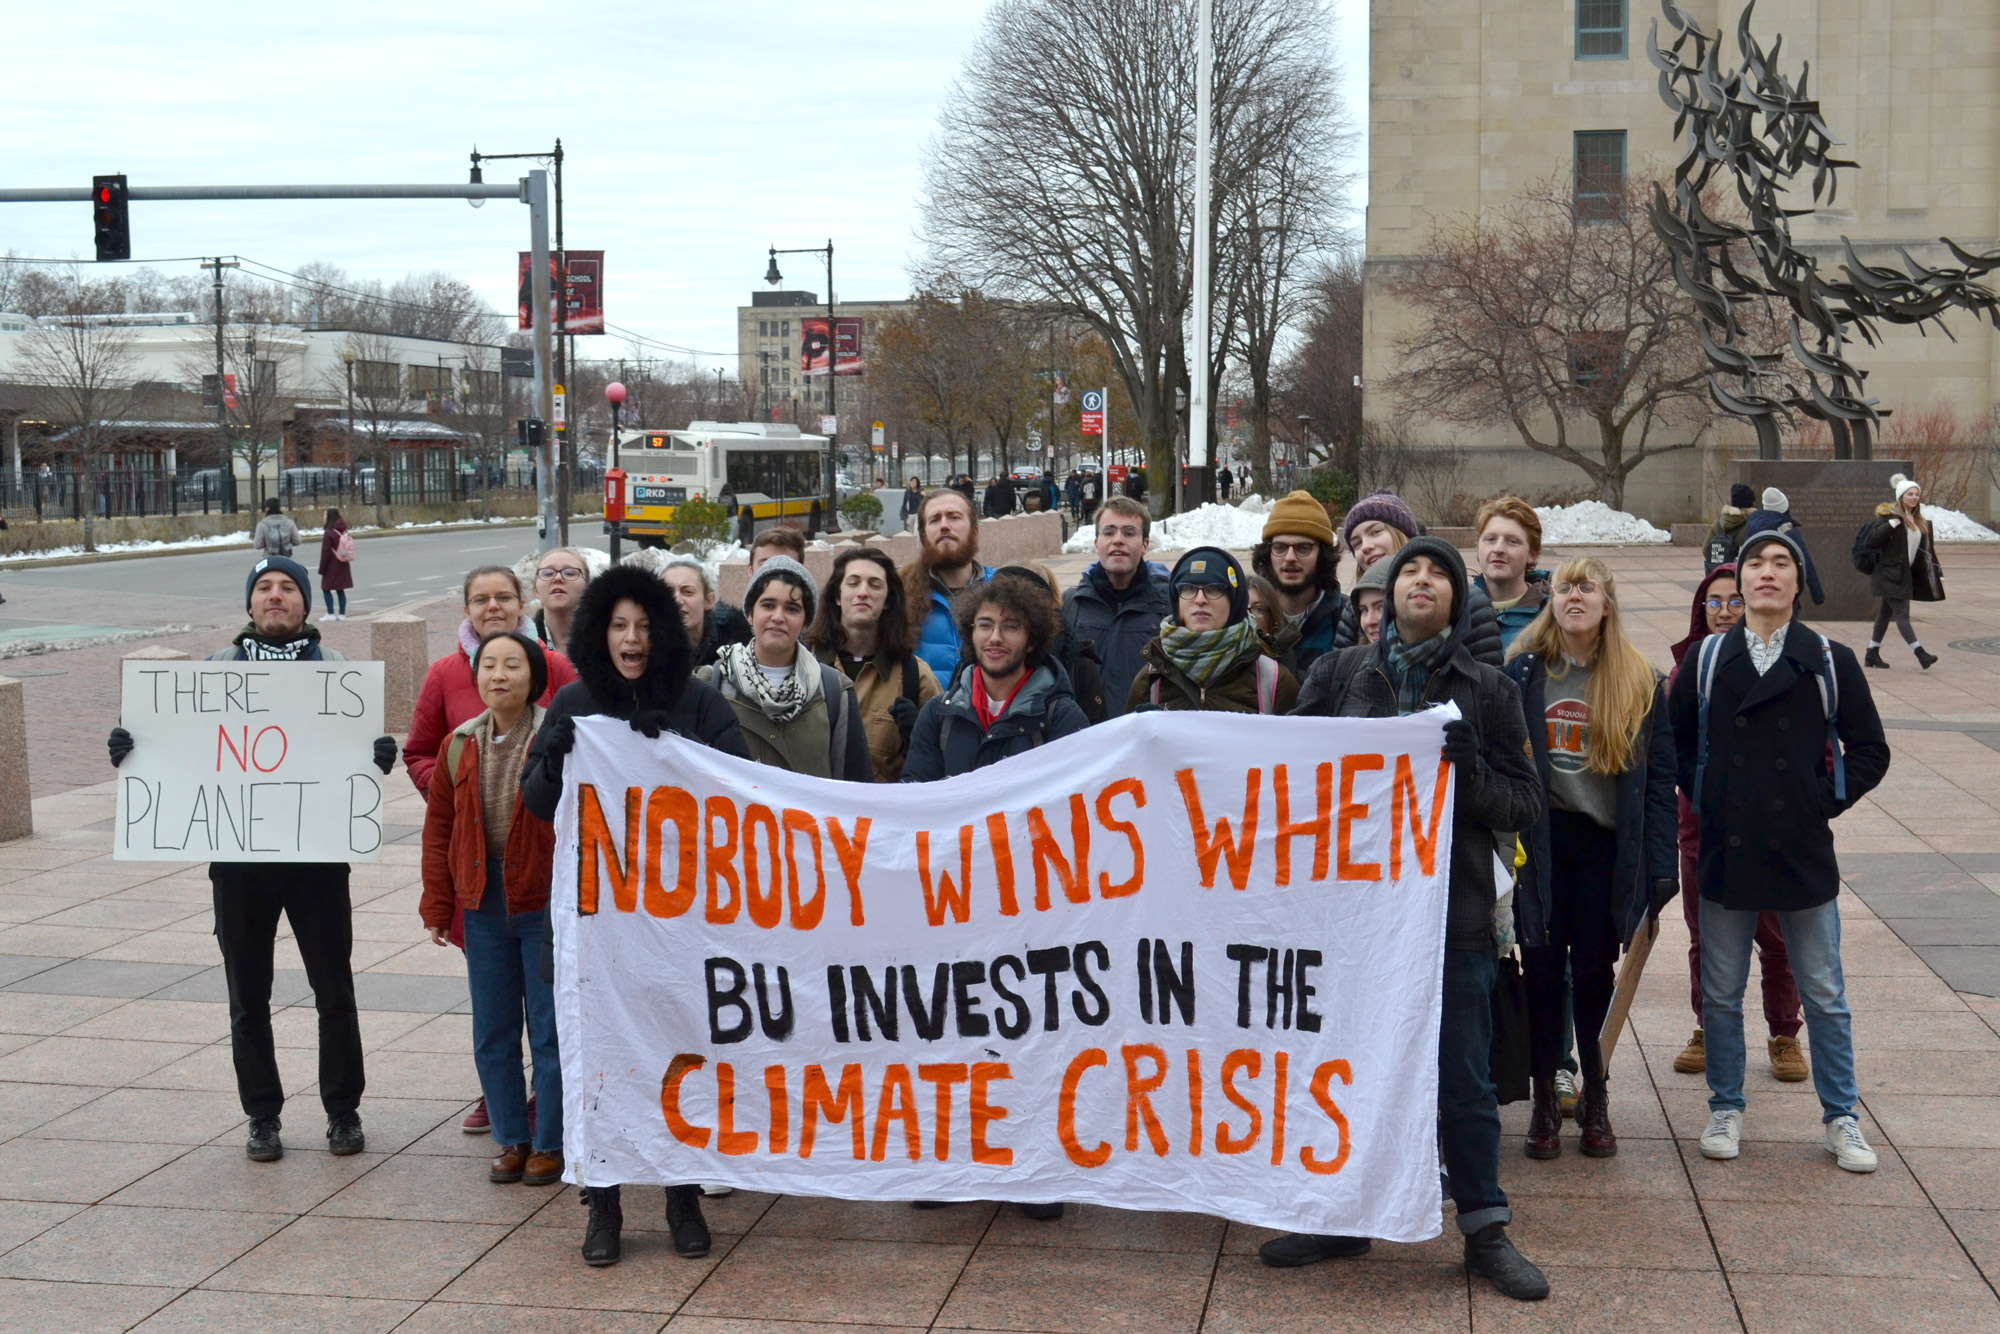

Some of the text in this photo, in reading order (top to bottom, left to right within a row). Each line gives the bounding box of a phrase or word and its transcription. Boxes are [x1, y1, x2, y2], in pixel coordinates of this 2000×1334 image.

[566, 275, 592, 283] SCHOOL
[566, 288, 575, 296] OF
[566, 301, 581, 309] LAW
[652, 437, 664, 448] 57
[140, 670, 365, 718] THERE IS
[216, 724, 288, 773] NO
[125, 773, 382, 854] PLANET B
[577, 747, 1452, 931] NOBODY WINS WHEN
[704, 937, 1323, 1045] BU INVESTS IN THE
[661, 1040, 1354, 1175] CLIMATE CRISIS
